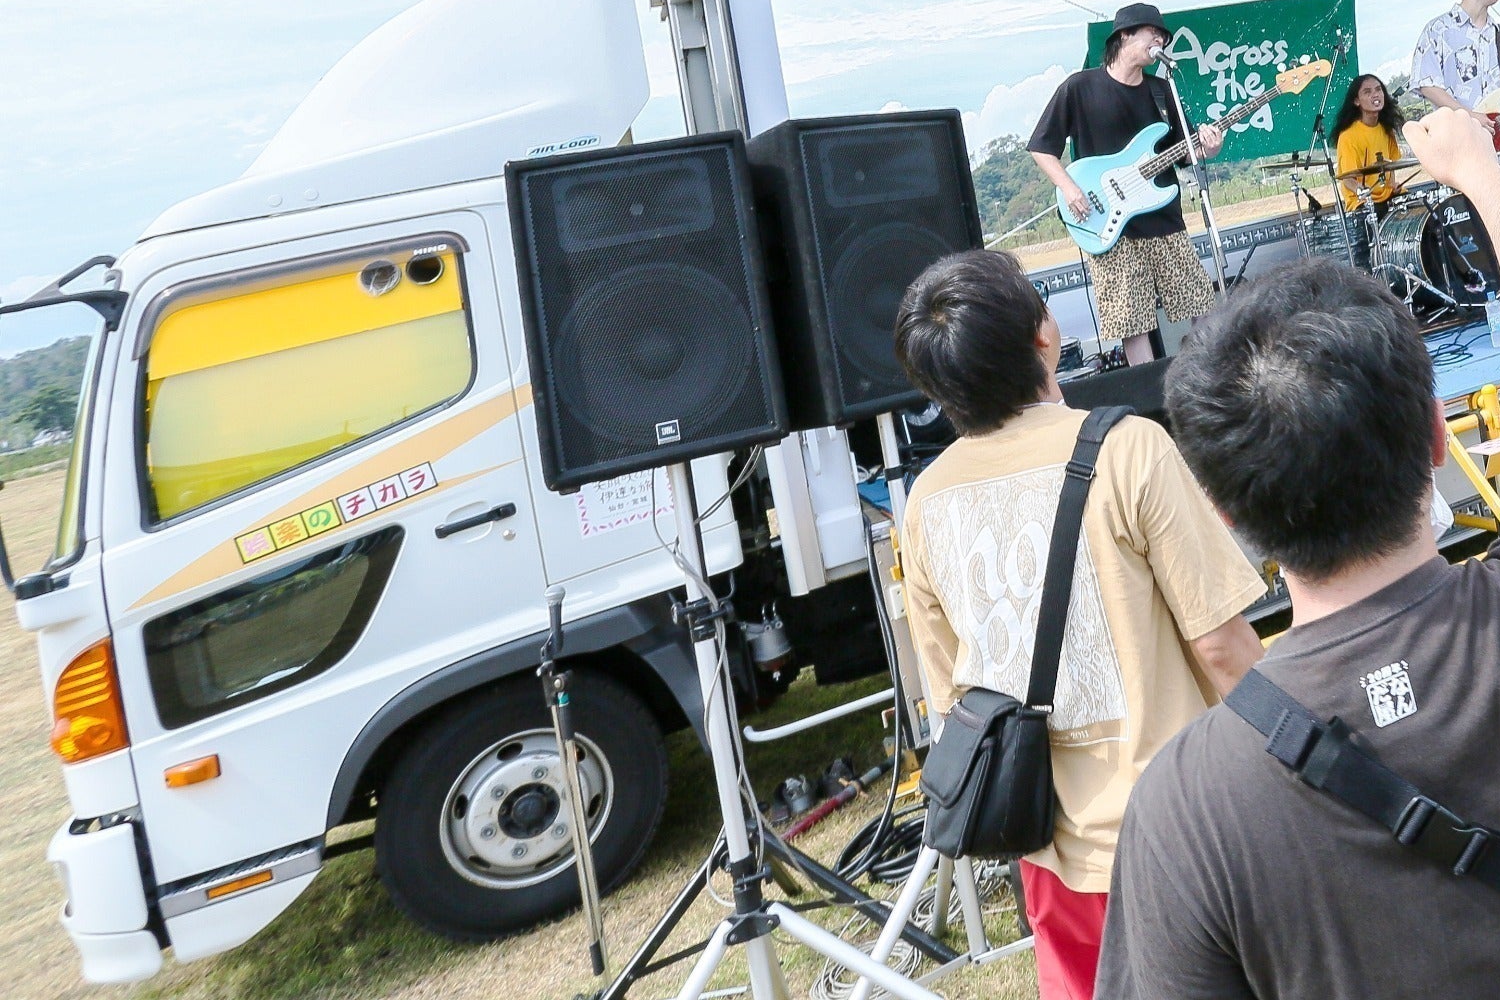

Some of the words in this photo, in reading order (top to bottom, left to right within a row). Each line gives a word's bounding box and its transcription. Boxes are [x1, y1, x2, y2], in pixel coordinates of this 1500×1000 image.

[1156, 26, 1289, 78] Across
[1211, 70, 1266, 102] the
[528, 145, 555, 156] AIR
[559, 137, 599, 150] LOOP
[413, 243, 447, 256] HINO
